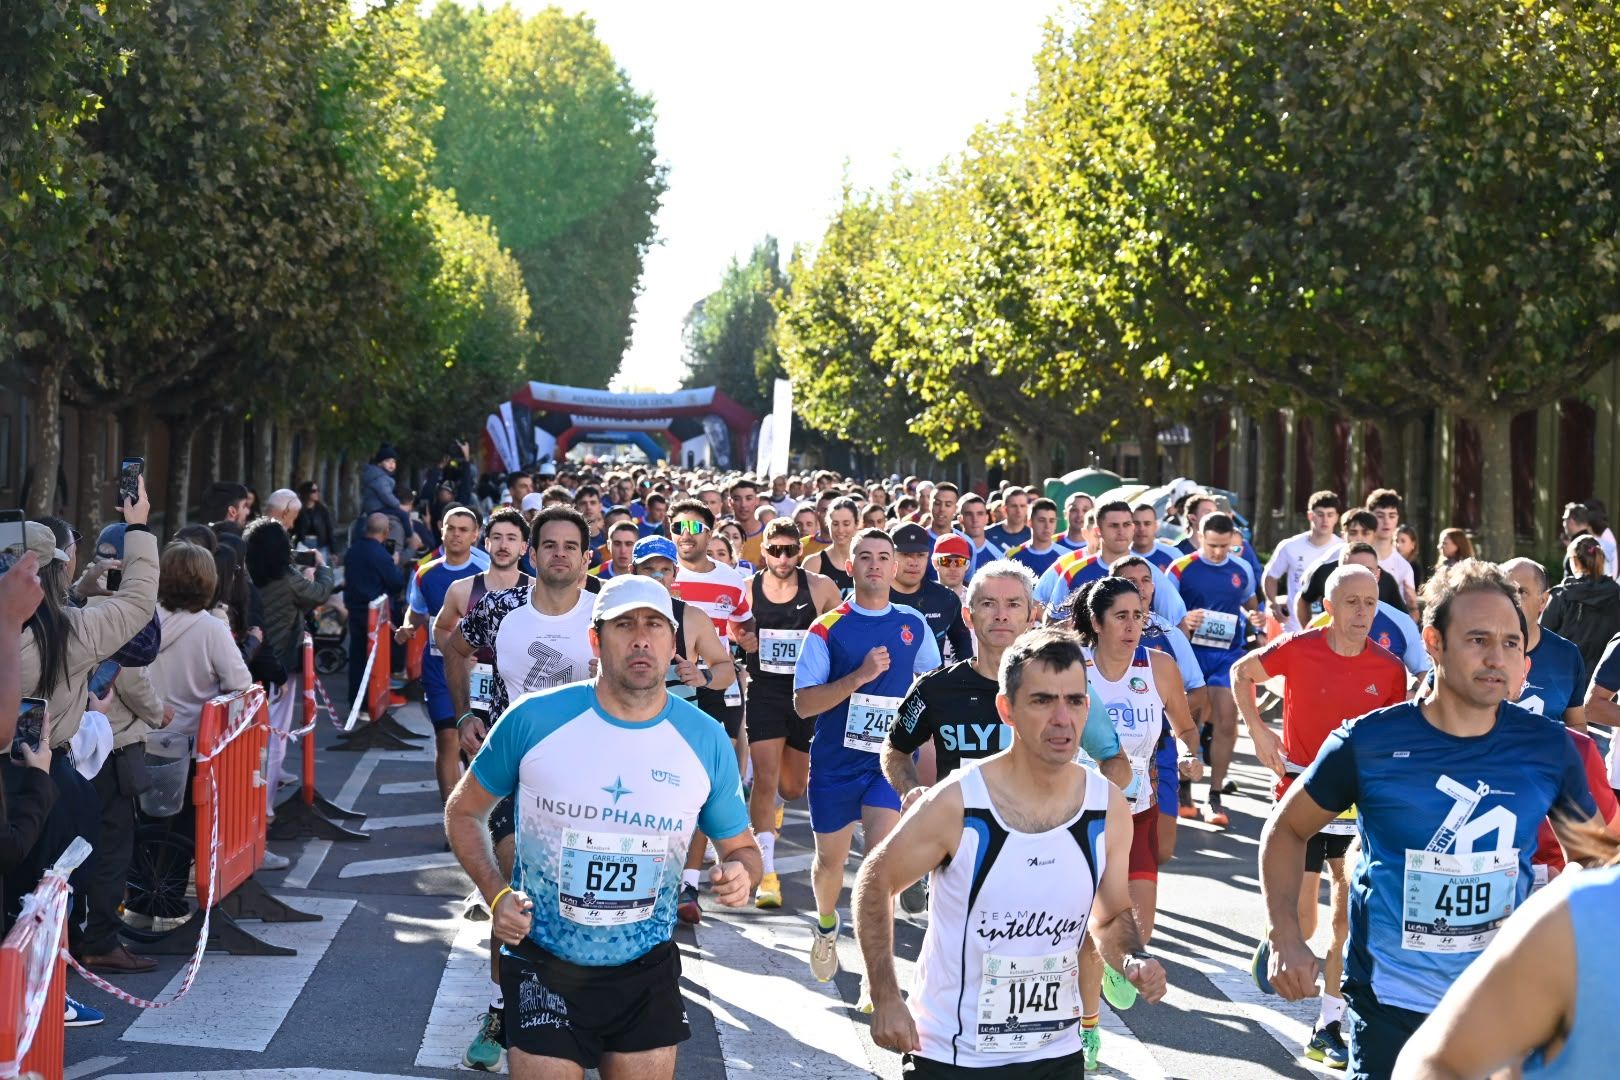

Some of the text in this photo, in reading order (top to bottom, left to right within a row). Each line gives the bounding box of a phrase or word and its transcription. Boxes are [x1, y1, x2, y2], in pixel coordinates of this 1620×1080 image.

[772, 642, 796, 658] 579
[1108, 703, 1155, 727] egui
[586, 861, 638, 892] 623
[1448, 877, 1480, 885] ALVARO
[1434, 882, 1491, 917] 499
[980, 910, 1028, 921] TEAM
[1009, 981, 1060, 1014] 1140
